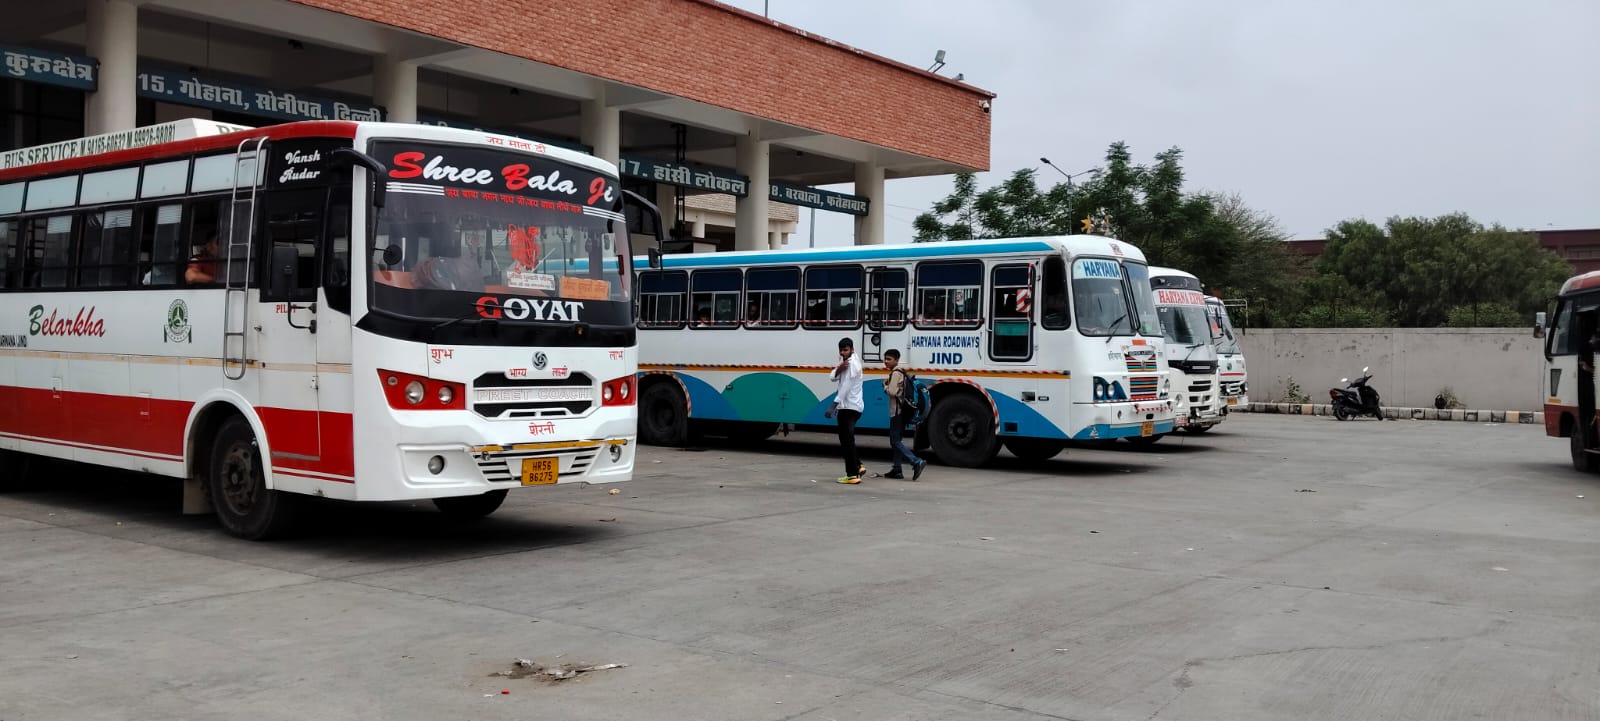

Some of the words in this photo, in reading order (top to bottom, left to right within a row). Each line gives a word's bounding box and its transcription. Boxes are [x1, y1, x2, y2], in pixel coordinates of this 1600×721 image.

[4, 51, 93, 81] कुरुक्षेत्र
[138, 73, 173, 95] 15.
[179, 78, 250, 110] गोहाना,
[255, 91, 328, 119] सोनीपत,
[486, 135, 504, 146] जय
[508, 139, 531, 150] माता
[535, 143, 547, 153] दी
[4, 152, 24, 169] BUS
[27, 141, 78, 165] SERVICE
[284, 149, 321, 165] Vansh
[279, 166, 320, 183] Rudar
[388, 151, 494, 184] Shree
[501, 163, 578, 195] Bala
[586, 177, 614, 205] Ji
[653, 163, 691, 185] हांसी
[694, 171, 746, 194] लोकल
[785, 187, 824, 207] बरवाला,
[826, 195, 867, 211] फतेहाबाद
[1082, 260, 1120, 278] HARYANA
[1158, 290, 1189, 304] HARYANA
[276, 303, 297, 313] PILT
[475, 296, 584, 321] GOYAT
[28, 304, 106, 337] Belarkha
[911, 336, 941, 348] HARYANA
[943, 336, 980, 348] ROADWAYS
[430, 348, 454, 364] शुभ
[608, 349, 624, 361] लाभ
[929, 352, 963, 364] JIND
[508, 367, 528, 377] भाग्य
[476, 389, 532, 401] PREET
[537, 388, 589, 400] COACH
[528, 421, 556, 436] शेरनी
[532, 460, 552, 472] HR56
[529, 471, 553, 482] B6275
